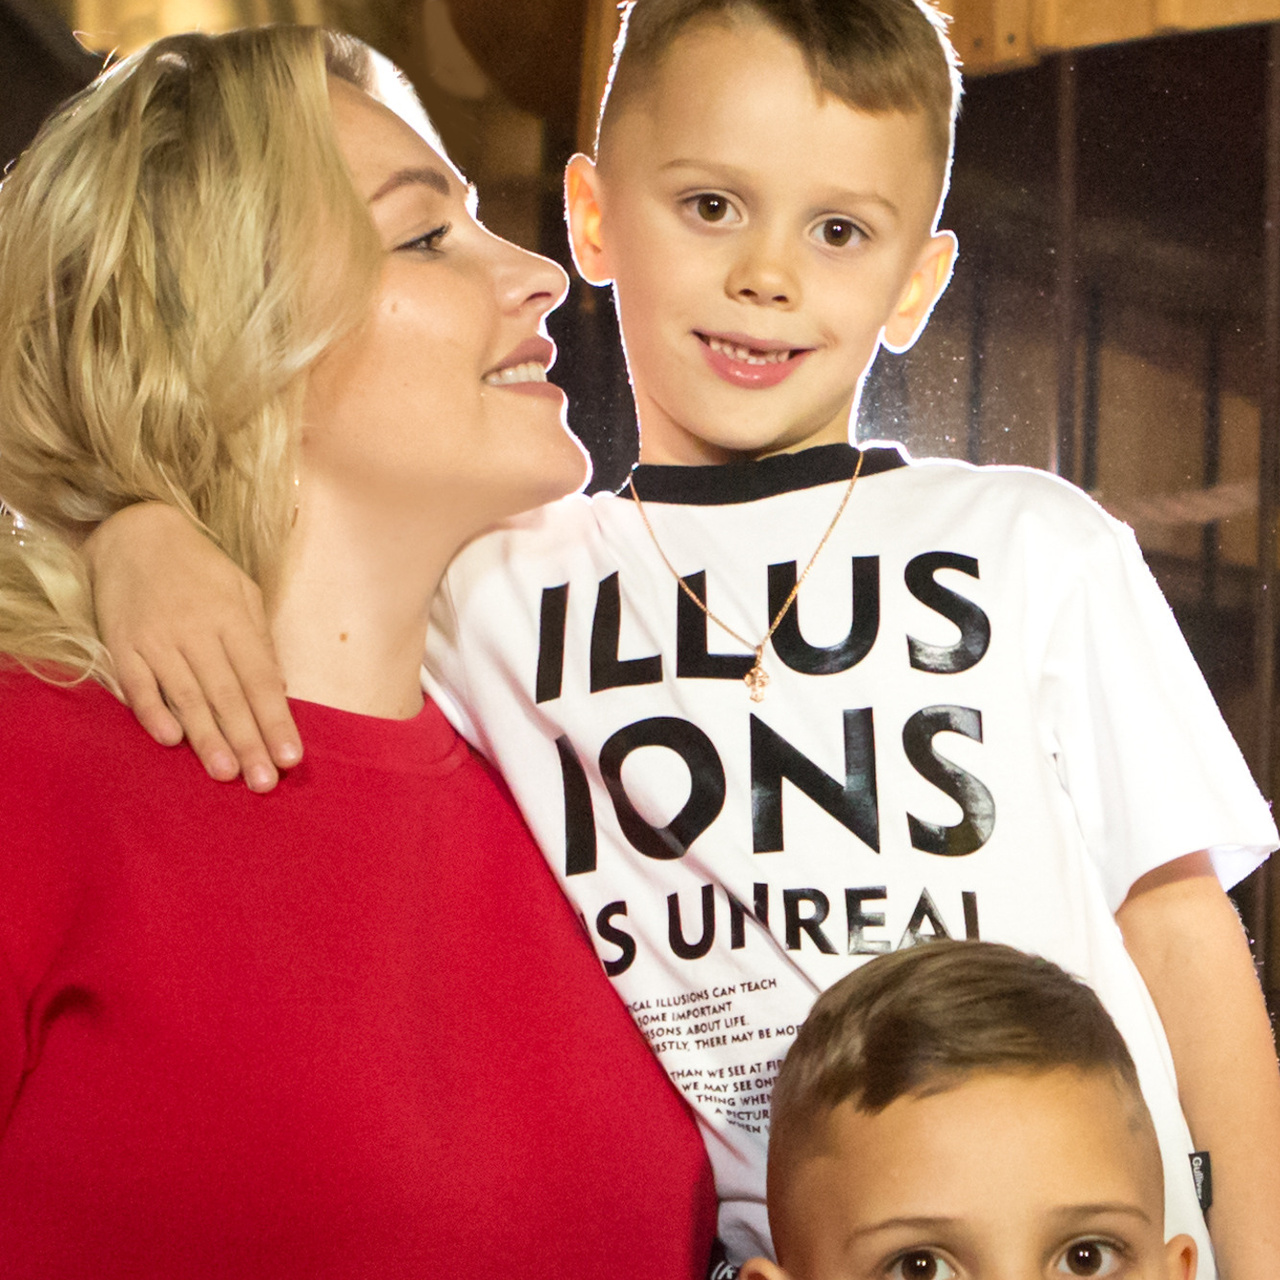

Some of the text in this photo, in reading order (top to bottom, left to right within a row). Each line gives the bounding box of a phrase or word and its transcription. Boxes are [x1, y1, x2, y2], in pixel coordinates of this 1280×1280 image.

[535, 550, 992, 705] ILLUS
[554, 703, 997, 877] IONS
[579, 899, 638, 979] S
[656, 986, 710, 1008] ILLUSIONS
[712, 985, 737, 999] CAN
[740, 977, 778, 994] TEACH
[637, 1001, 733, 1028] SOME IMPORTANT
[686, 1019, 722, 1036] ABOUT
[694, 1035, 728, 1051] THERE
[731, 1030, 755, 1044] MAY
[758, 1028, 772, 1039] BE
[670, 1068, 703, 1082] THAN
[706, 1068, 725, 1079] WE
[728, 1064, 746, 1077] SEE
[749, 1062, 762, 1074] AT
[681, 1081, 699, 1092] WE
[703, 1082, 729, 1093] MAY
[733, 1081, 753, 1093] SEE
[696, 1094, 736, 1107] THING
